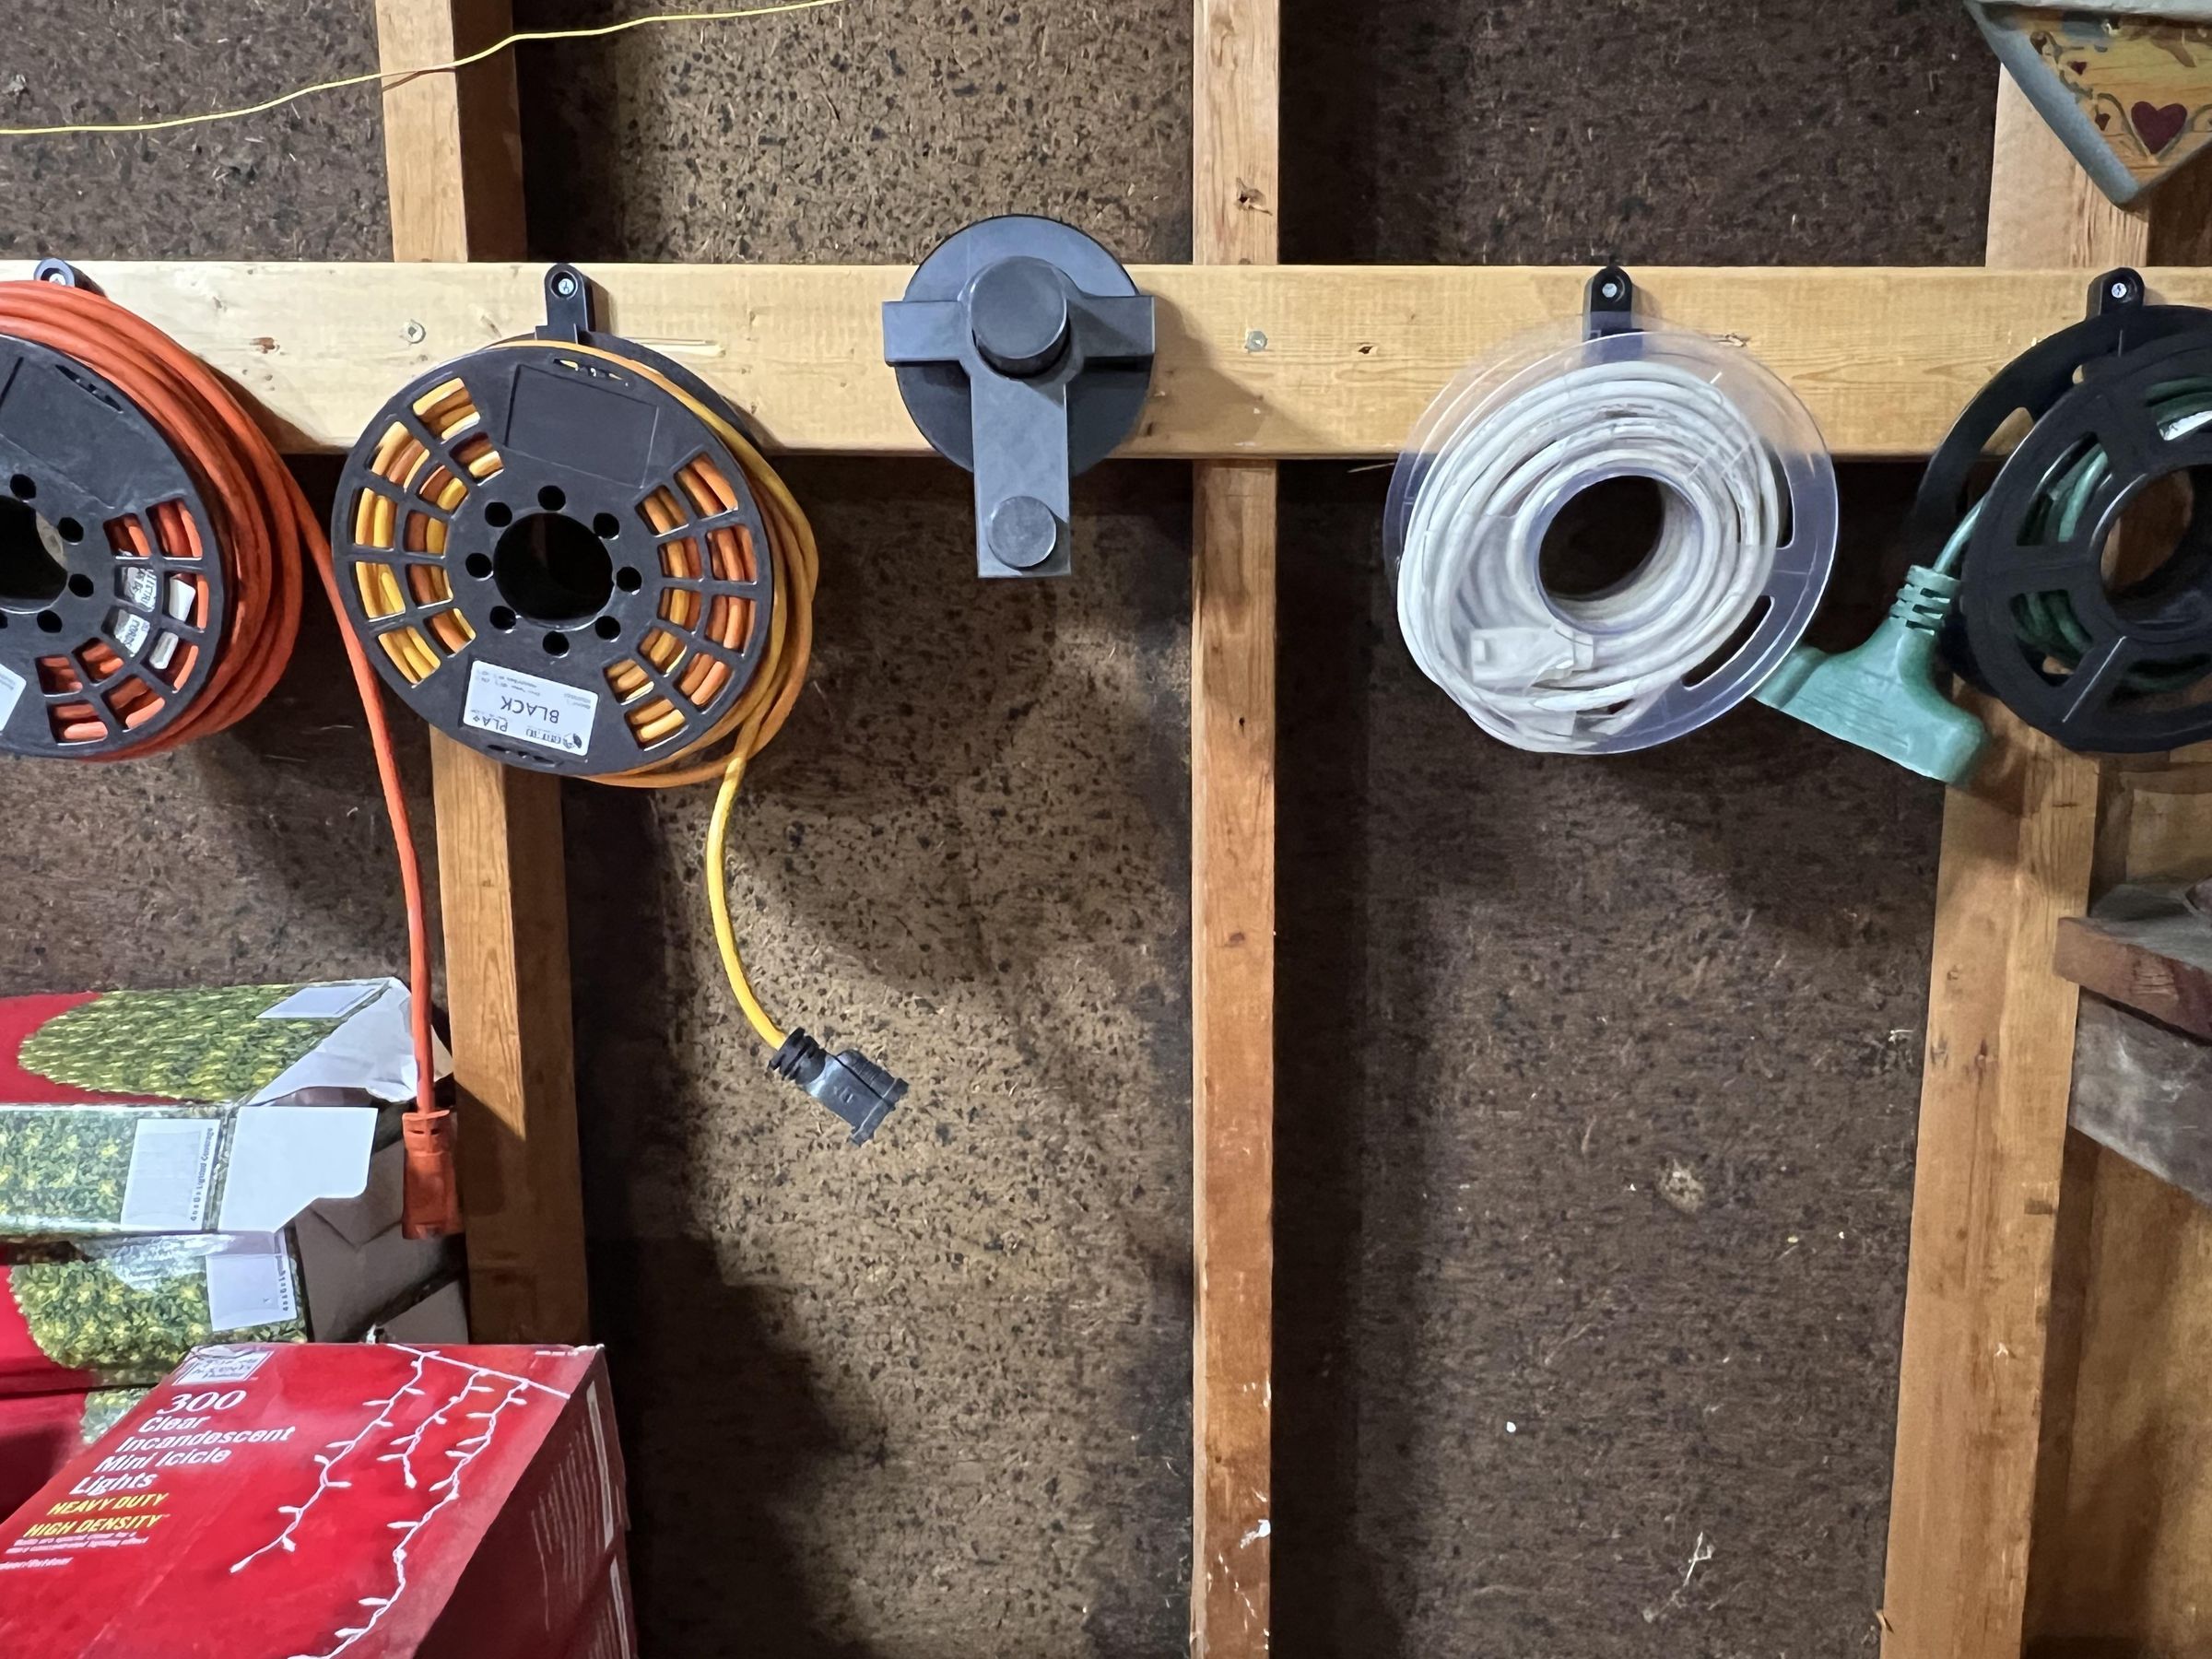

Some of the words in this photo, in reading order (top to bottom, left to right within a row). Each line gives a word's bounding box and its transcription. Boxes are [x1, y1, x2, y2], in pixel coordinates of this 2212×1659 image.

[500, 696, 559, 724] BLACK
[157, 1390, 247, 1415] 300
[138, 1416, 211, 1433] Clear
[115, 1426, 296, 1453] Incandescent
[93, 1452, 158, 1473] Mini
[155, 1447, 232, 1467] Icicle
[69, 1473, 159, 1497] Lights
[47, 1498, 116, 1516] HEAVY
[112, 1492, 170, 1510] DUTY
[23, 1521, 78, 1538] HIGH
[74, 1514, 164, 1534] DENSITY
